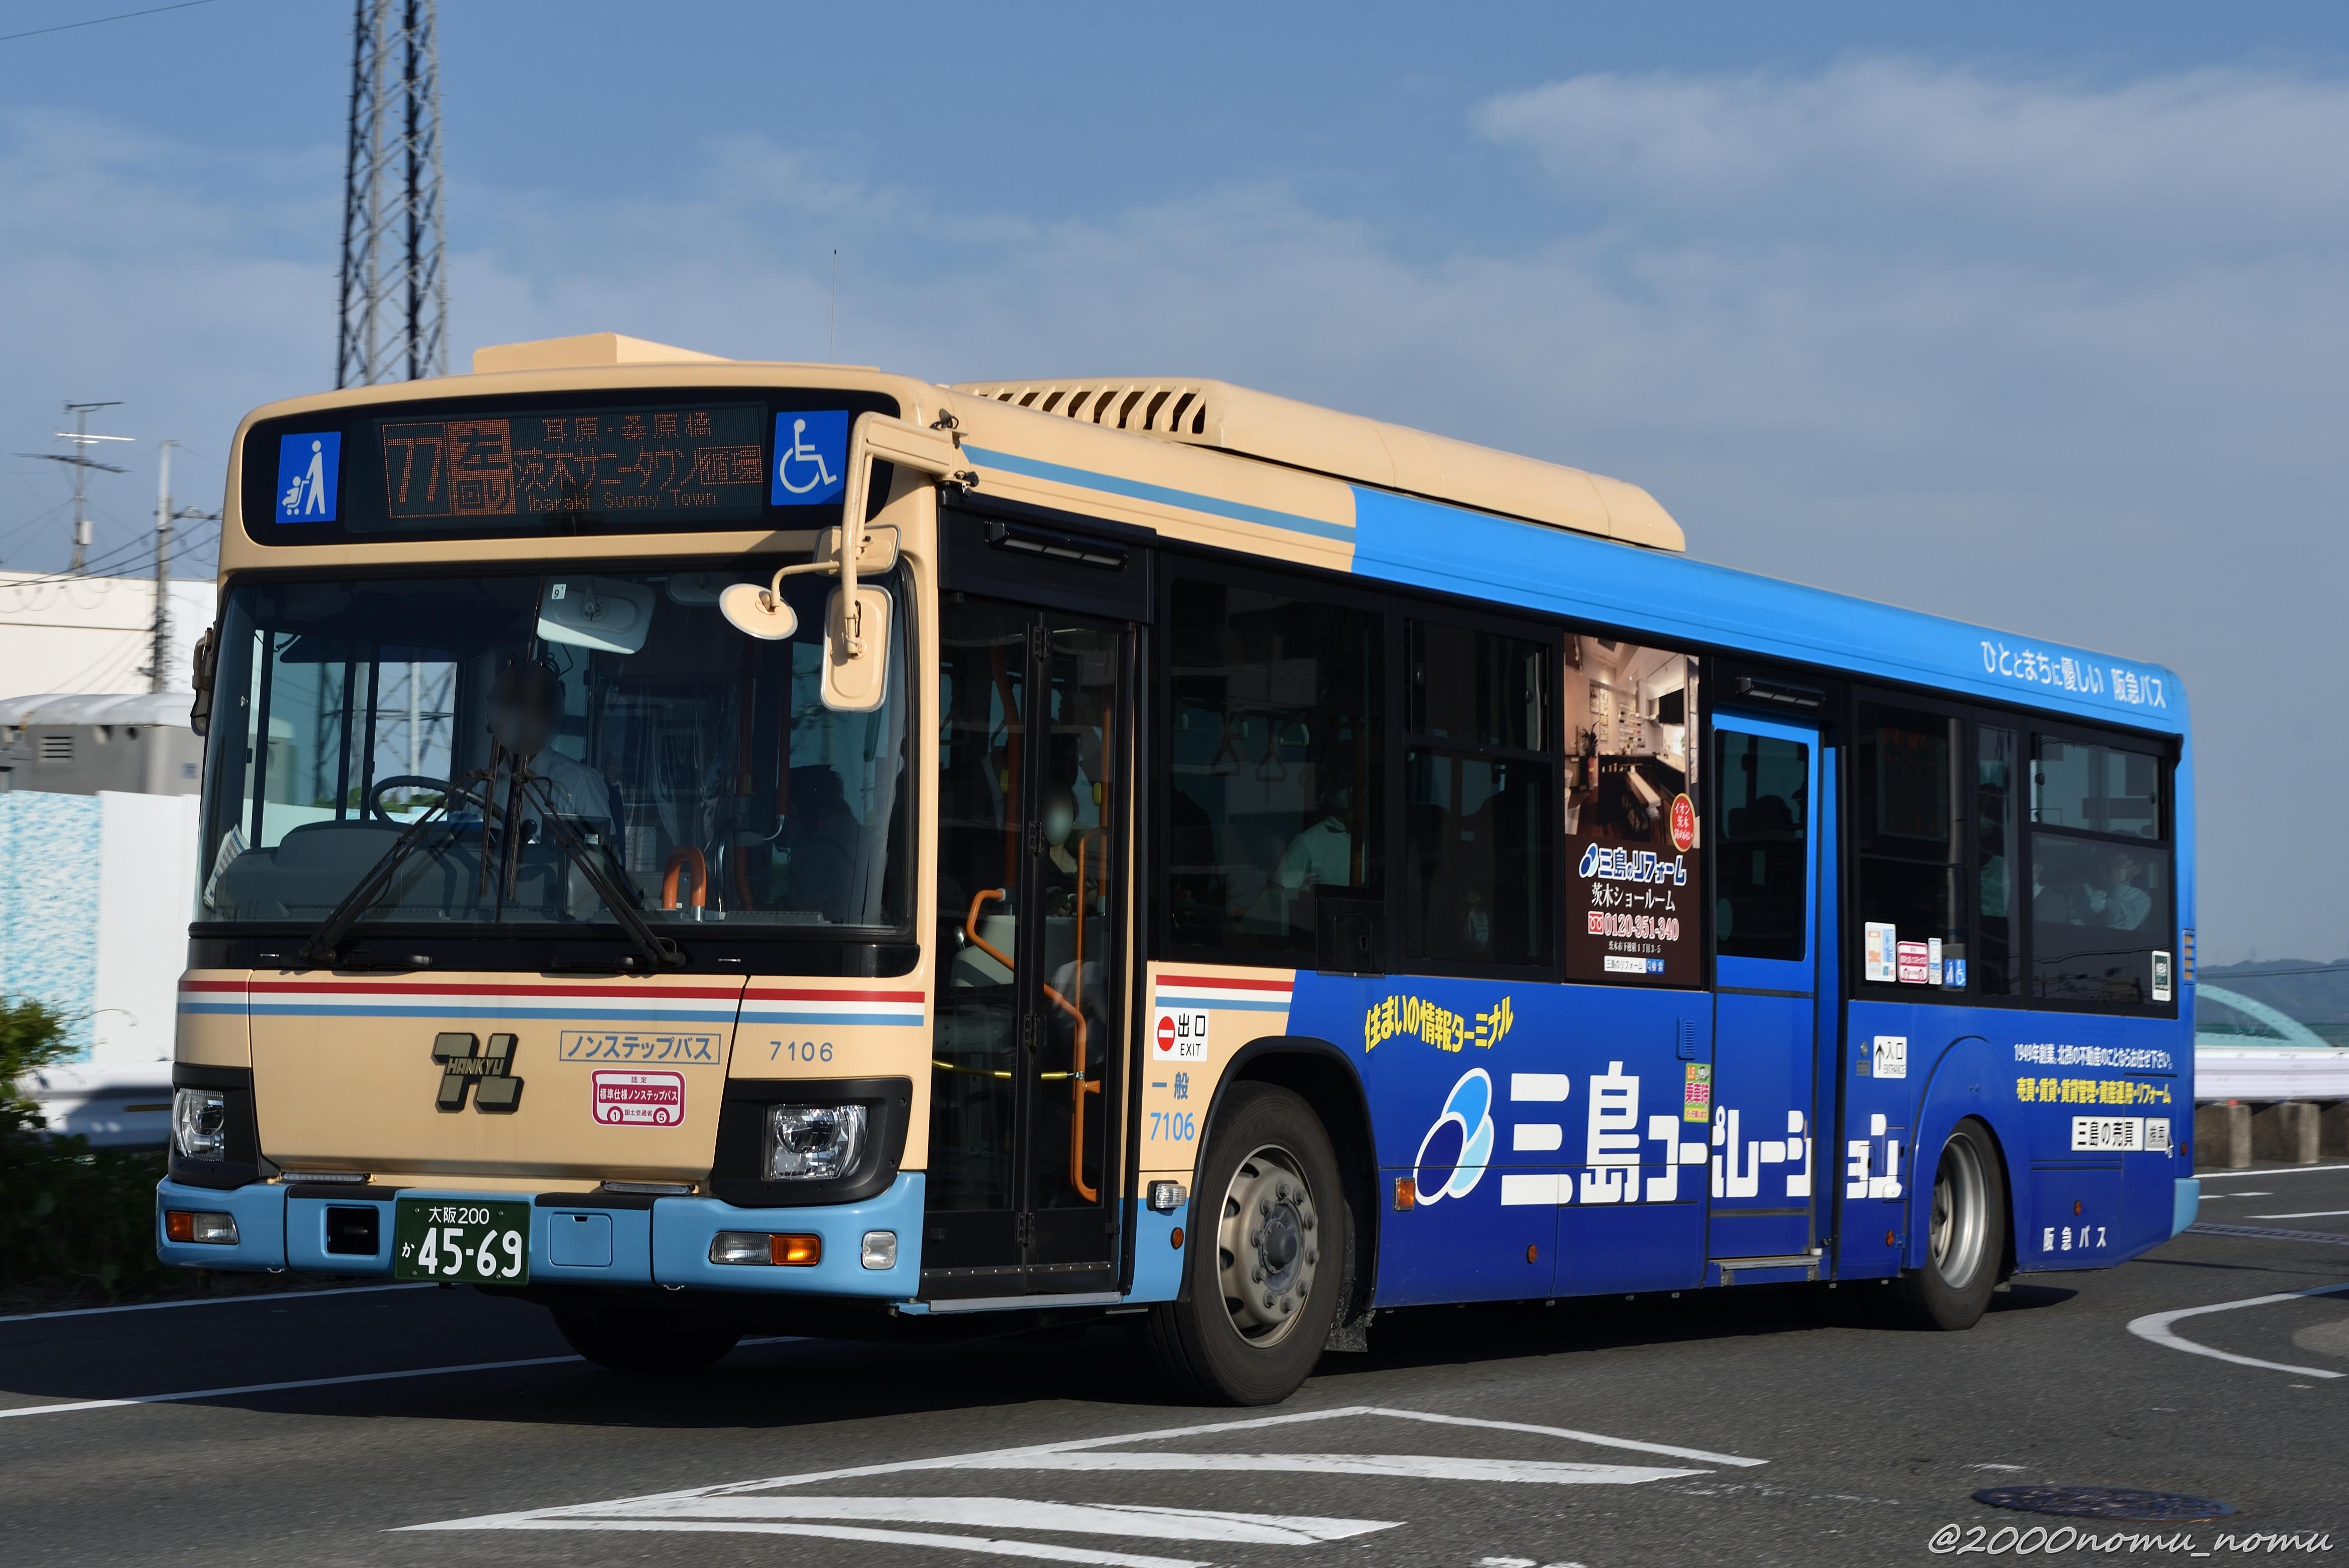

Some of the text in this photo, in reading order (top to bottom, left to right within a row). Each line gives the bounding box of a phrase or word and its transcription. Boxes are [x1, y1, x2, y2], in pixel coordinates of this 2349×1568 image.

[388, 437, 443, 503] 77
[702, 448, 762, 483] 循環
[455, 478, 511, 511] 回り
[529, 487, 716, 512] Ibaraki Sunny Town
[1980, 640, 2167, 709] ひととまちに優しい 阪急バス
[1674, 802, 1691, 815] イオン
[1676, 815, 1690, 829] 茨木
[1598, 846, 1687, 886] 三島のリフォーム
[1590, 881, 1676, 912] 茨木ショールーム
[1604, 912, 1680, 942] 0120-351-340
[1178, 1013, 1206, 1037] 出口
[1365, 994, 1514, 1054] 住まいの情報ターミナル
[567, 1035, 712, 1061] ノンステップバス
[770, 1040, 834, 1062] 7106
[1180, 1043, 1201, 1056] EXIT
[1885, 1041, 1904, 1060] 入口
[446, 1057, 505, 1075] HANKYU
[1883, 1063, 1906, 1075] ENTRANCE
[600, 1088, 678, 1102] 標準仕様ノンステップバス
[1152, 1071, 1190, 1100] 一般
[624, 1109, 653, 1117] 国土交通省
[658, 1113, 664, 1122] 5
[1150, 1112, 1195, 1141] 7106
[2076, 1120, 2134, 1147] 三島の売買
[2043, 1224, 2107, 1252] 阪急バス
[401, 1227, 522, 1278] か 45-69
